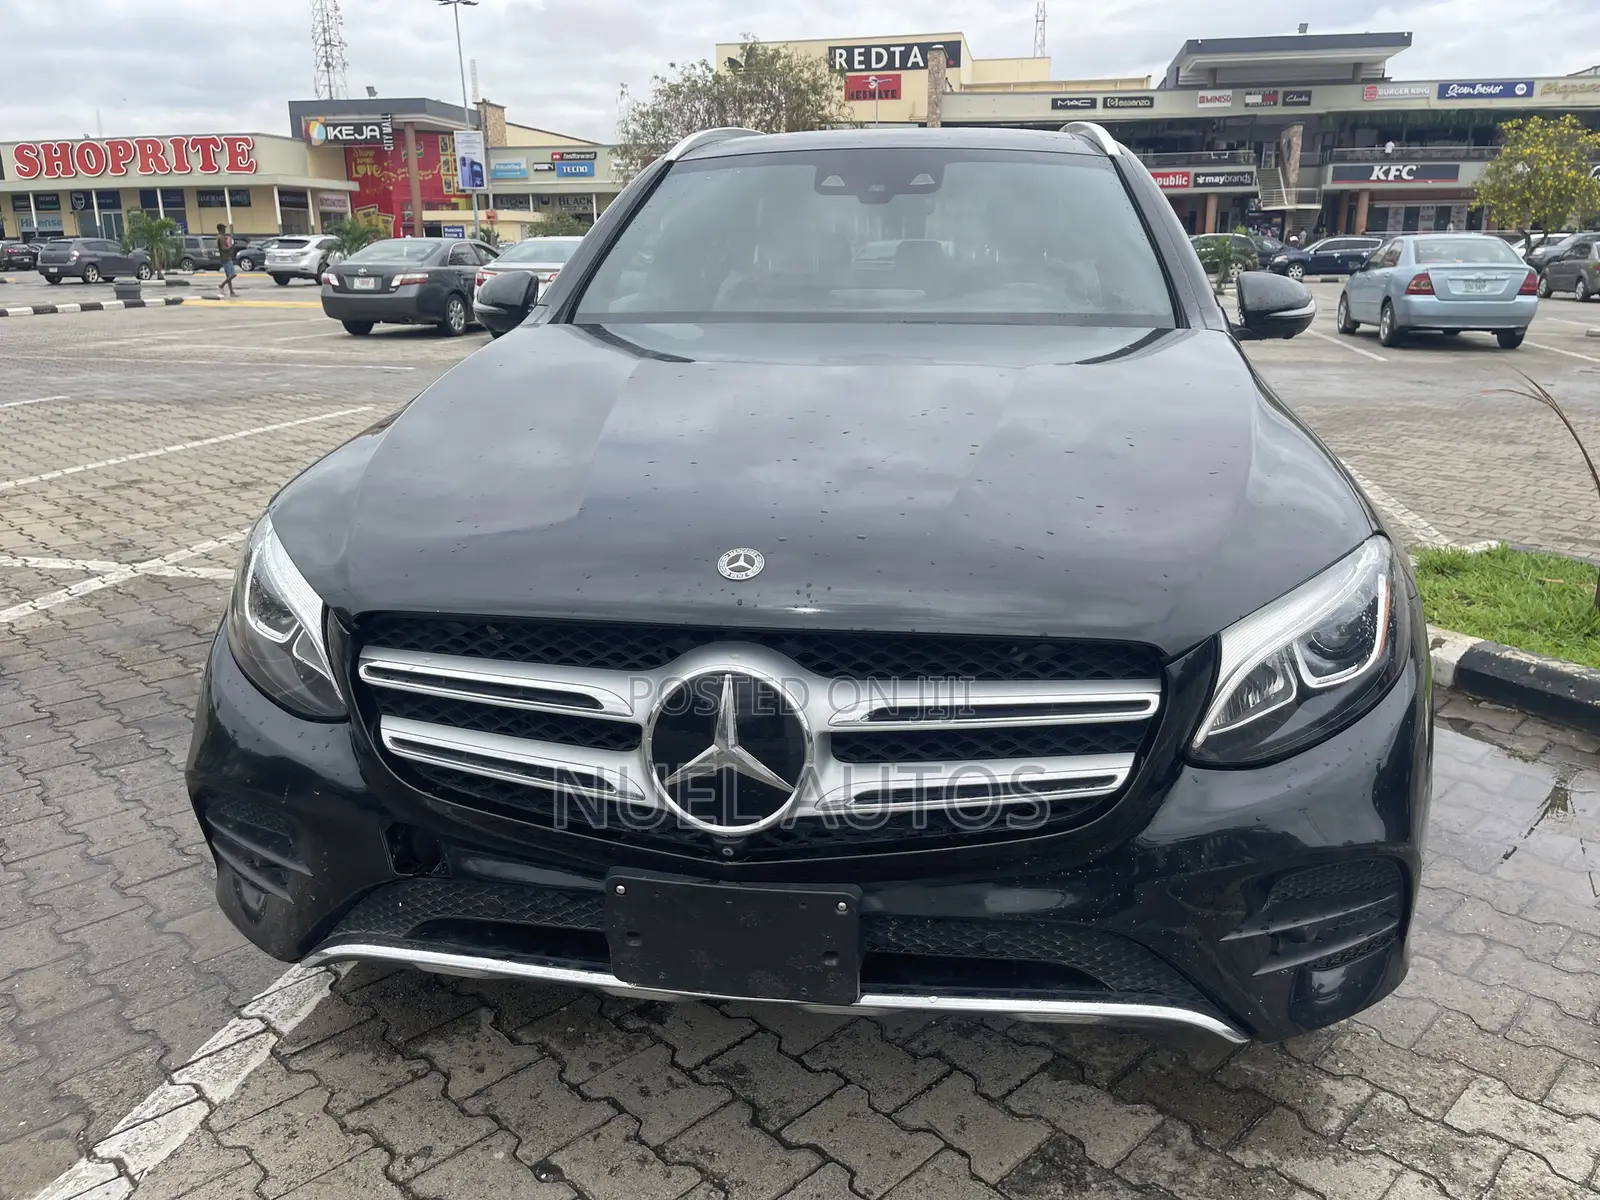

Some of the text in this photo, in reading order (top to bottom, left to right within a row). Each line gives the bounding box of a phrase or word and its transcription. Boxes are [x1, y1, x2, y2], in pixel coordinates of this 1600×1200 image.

[835, 45, 925, 70] REDTA
[1378, 88, 1409, 96] BURGER
[1411, 87, 1430, 95] KING
[382, 114, 393, 133] MALL
[327, 125, 380, 139] IKEJA
[384, 134, 394, 151] CITY
[13, 135, 257, 179] SHOPRITE
[1156, 174, 1189, 186] public
[1369, 165, 1417, 180] KFC
[558, 196, 593, 206] BLACK
